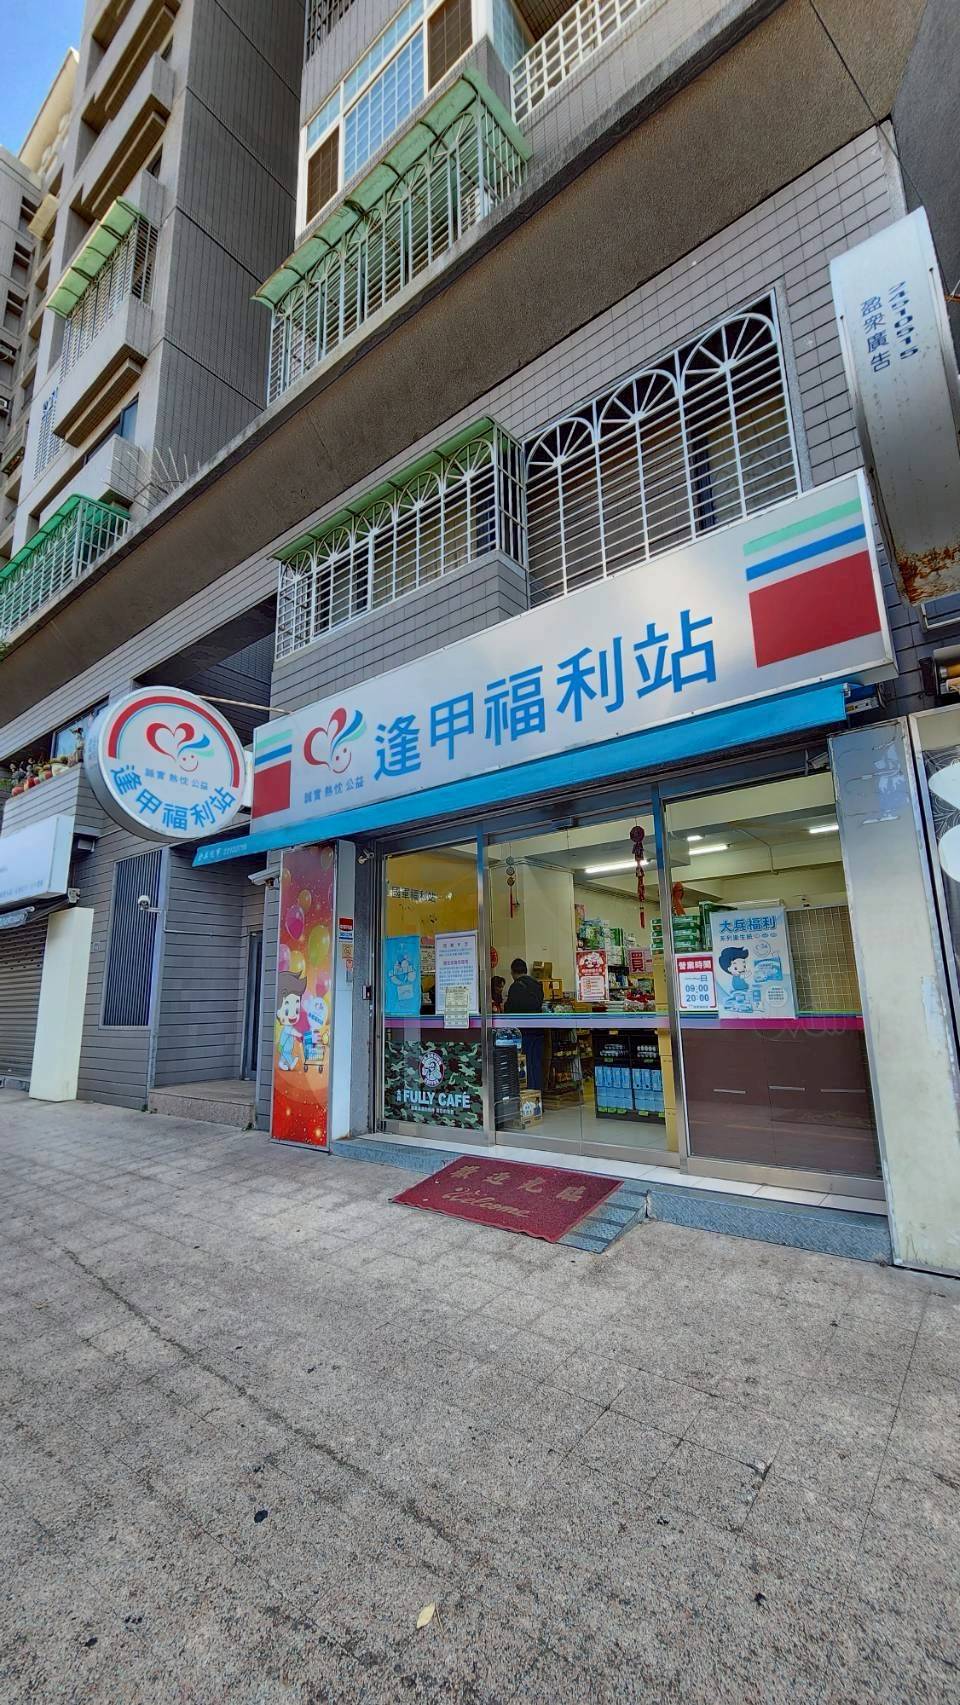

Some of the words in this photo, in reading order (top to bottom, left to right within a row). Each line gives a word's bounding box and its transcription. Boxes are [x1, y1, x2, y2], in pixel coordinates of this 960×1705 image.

[374, 609, 717, 782] 逢甲福利站
[346, 776, 364, 791] 公益
[110, 764, 236, 831] 逢甲福利站
[720, 916, 777, 933] 大兵福利
[678, 960, 712, 970] 營業時間
[685, 984, 709, 993] 09:00
[686, 994, 710, 1003] 20:00
[404, 1089, 435, 1105] FULLY
[438, 1092, 470, 1109] CAFÉ
